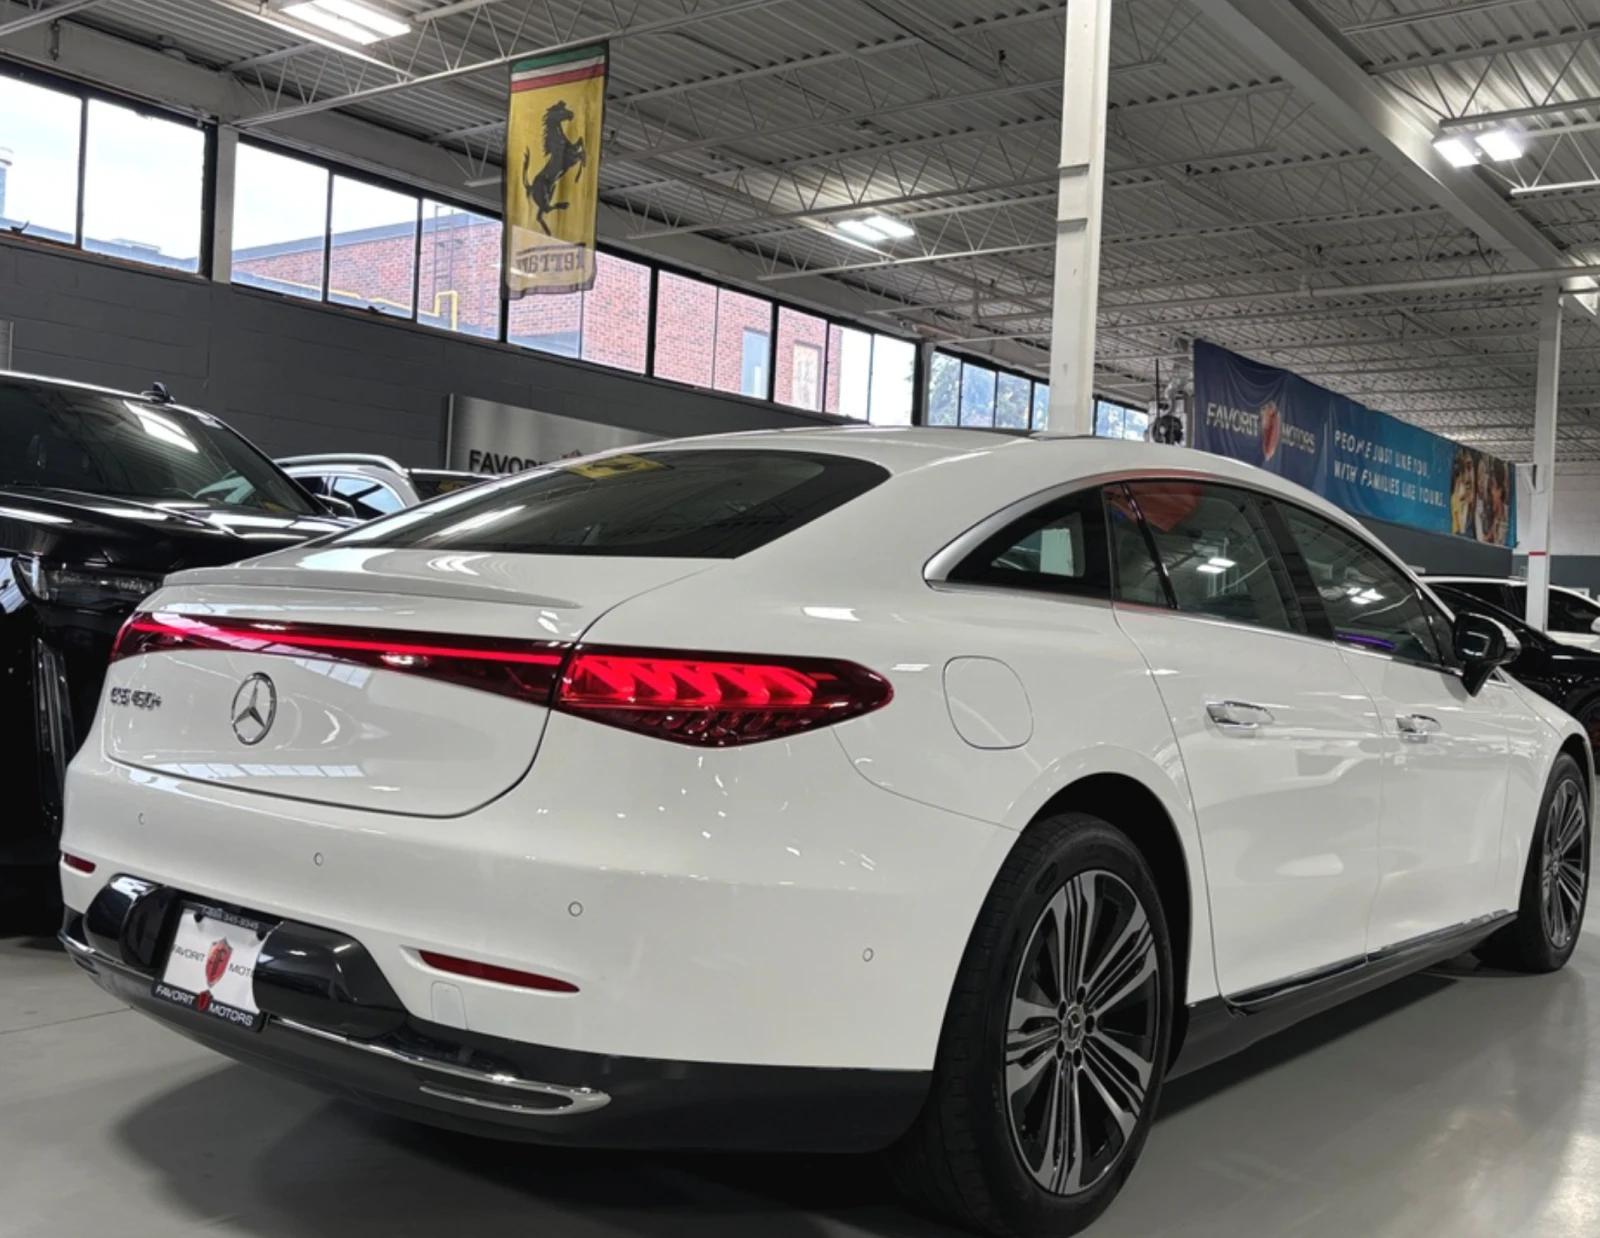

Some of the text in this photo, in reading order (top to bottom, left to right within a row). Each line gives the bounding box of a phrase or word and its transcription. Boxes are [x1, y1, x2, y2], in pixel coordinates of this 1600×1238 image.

[1206, 402, 1316, 456] FAVORIT MOTORS
[1334, 429, 1373, 460] PEOPLE
[1373, 444, 1393, 466] JUST
[1395, 451, 1412, 472] LIKE
[1334, 459, 1358, 484] WITH
[1360, 468, 1400, 497] FAMILIES
[155, 984, 254, 1028] FAVORIT MOTORS
